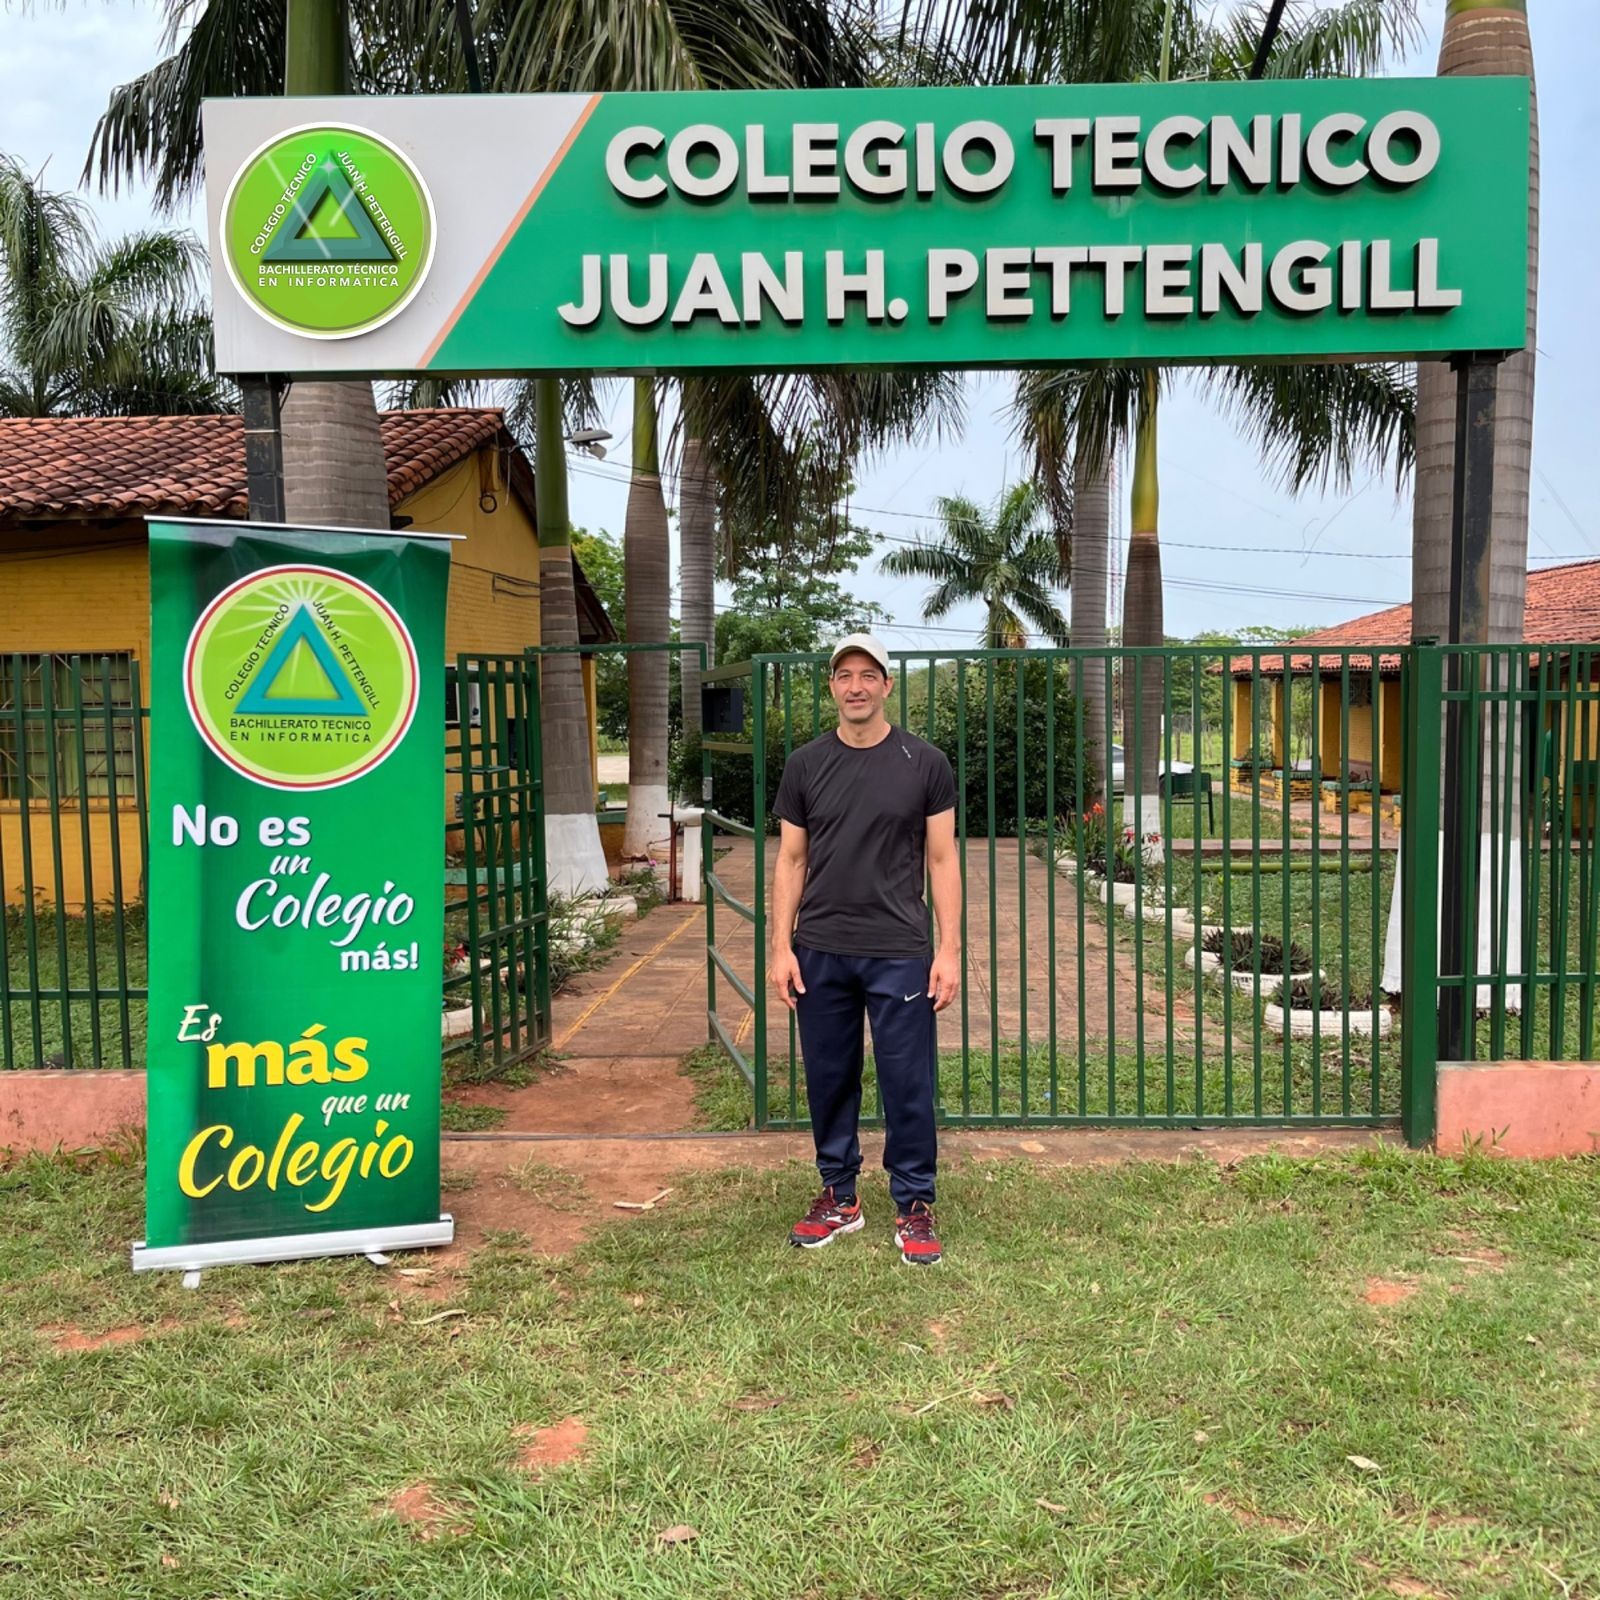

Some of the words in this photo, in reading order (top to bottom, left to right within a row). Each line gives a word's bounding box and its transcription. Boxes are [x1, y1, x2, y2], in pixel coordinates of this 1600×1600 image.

[605, 120, 1015, 199] COLEGIO
[1035, 110, 1441, 190] TECNICO
[250, 204, 285, 254] COLEGIO
[281, 153, 317, 203] TECNICO
[338, 151, 361, 182] JUAN
[356, 181, 368, 195] H.
[365, 195, 408, 260] PETTENGILL
[258, 265, 344, 275] BACHILLERATO
[347, 262, 399, 275] TÉCNICO
[258, 277, 278, 287] EN
[288, 277, 399, 287] INFORMATICA
[557, 251, 804, 326] JUAN
[825, 249, 909, 320] H.
[928, 237, 1463, 319] PETTENGILL
[224, 651, 260, 700] COLEGIO
[256, 604, 289, 650] TECNICO
[312, 601, 336, 630] JUAN
[331, 630, 342, 644] H.
[338, 644, 380, 710] PETTENGILL
[230, 718, 318, 729] BACHILLERATO
[321, 719, 372, 730] TECNICO
[230, 731, 249, 741] EN
[260, 732, 371, 743] INFORMATICA
[172, 803, 239, 847] No
[258, 816, 312, 847] es
[269, 855, 312, 876] un
[235, 872, 414, 947] Colegio
[340, 941, 419, 972] más!
[176, 1003, 222, 1042] Es
[206, 1023, 369, 1089] más
[321, 1094, 368, 1127] que
[375, 1091, 411, 1112] un
[178, 1112, 414, 1213] Colegio
